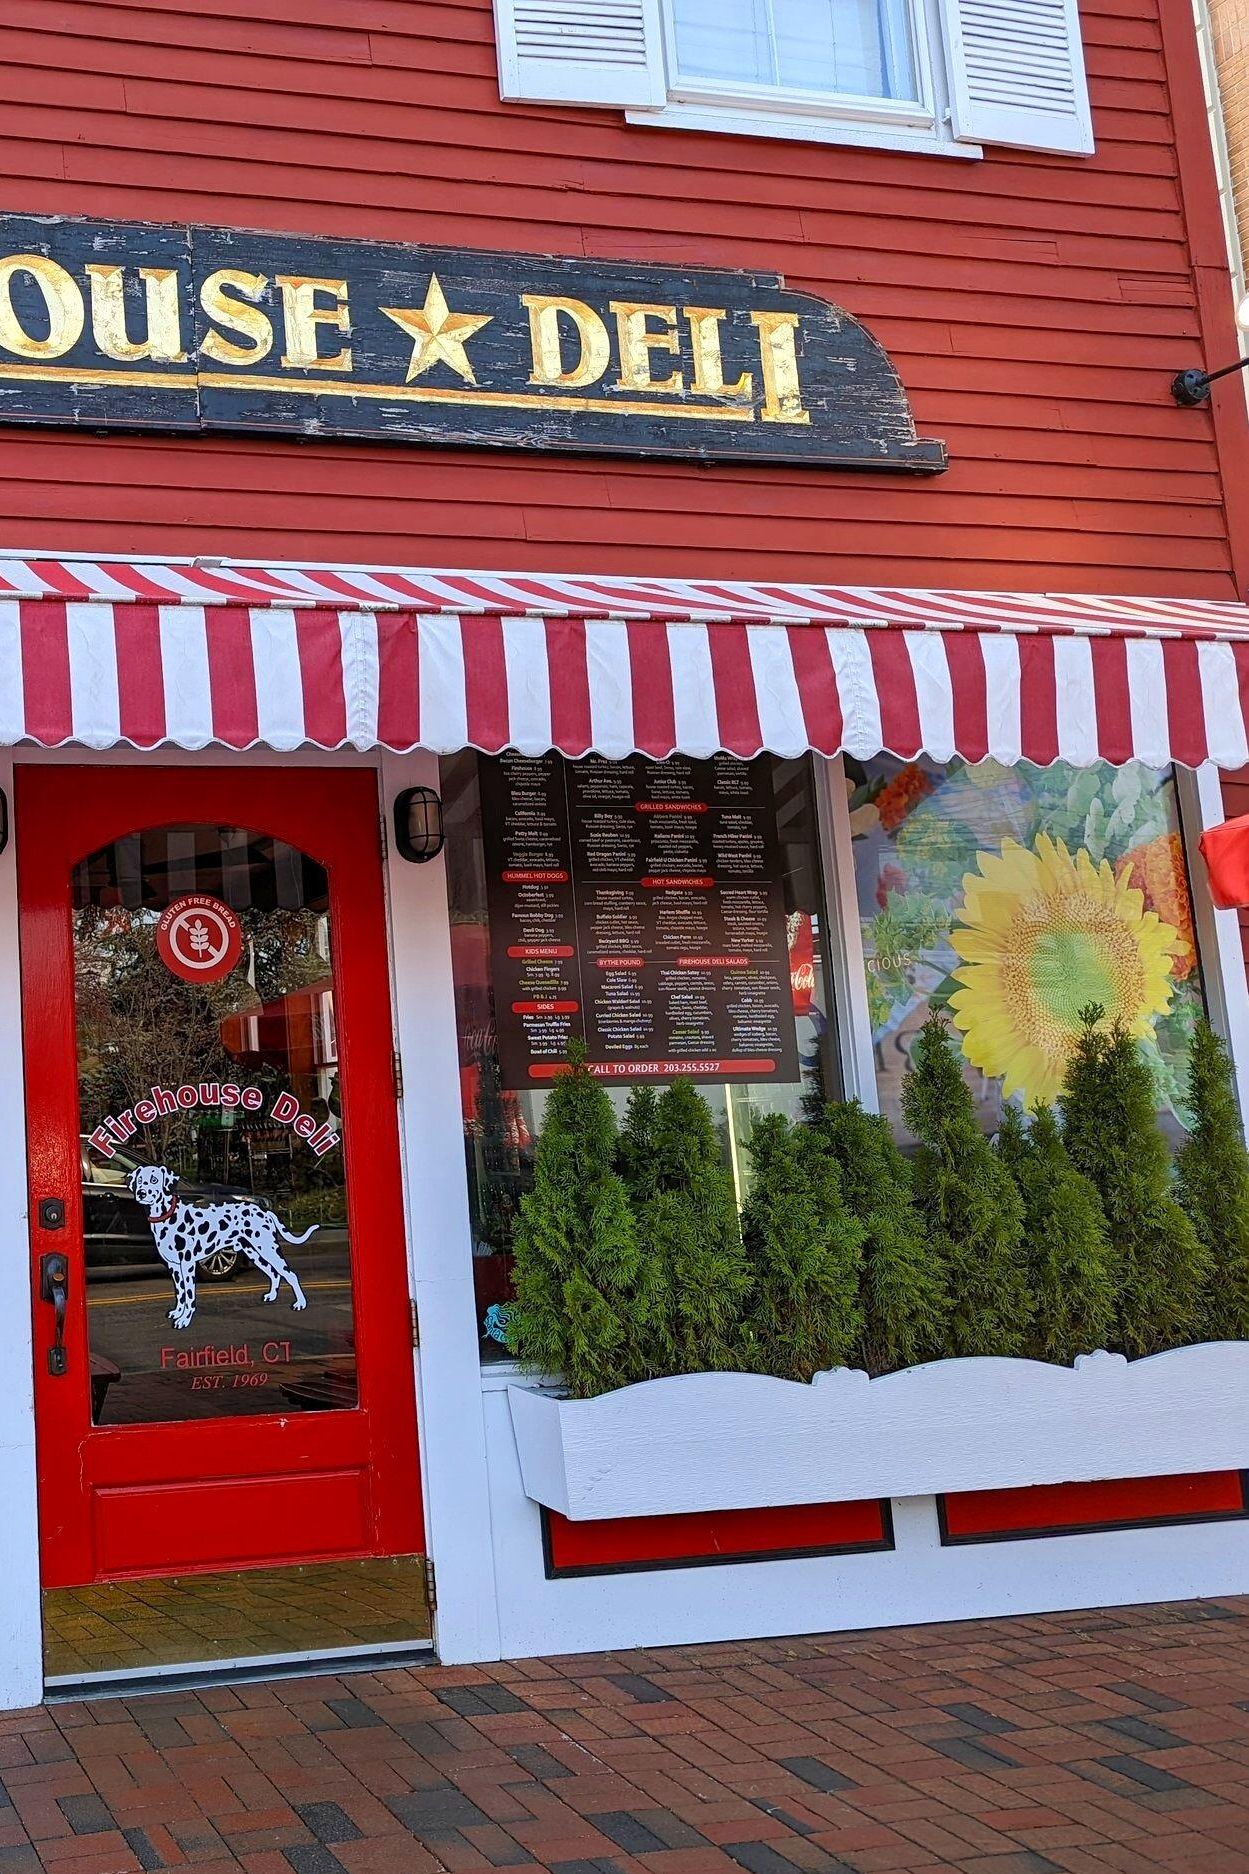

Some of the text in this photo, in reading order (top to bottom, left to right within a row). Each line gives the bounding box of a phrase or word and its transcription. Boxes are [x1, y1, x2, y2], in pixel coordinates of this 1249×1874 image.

[521, 291, 813, 424] DELI
[160, 897, 236, 931] GLUTEN FREE BREAD
[867, 953, 911, 972] CIOUS
[588, 1063, 720, 1074] CALL TO ORDER 203.255.5527
[88, 1083, 341, 1158] Firehouse Deli
[160, 1341, 292, 1370] Fairfield, CT
[191, 1371, 268, 1391] EST. 1969
